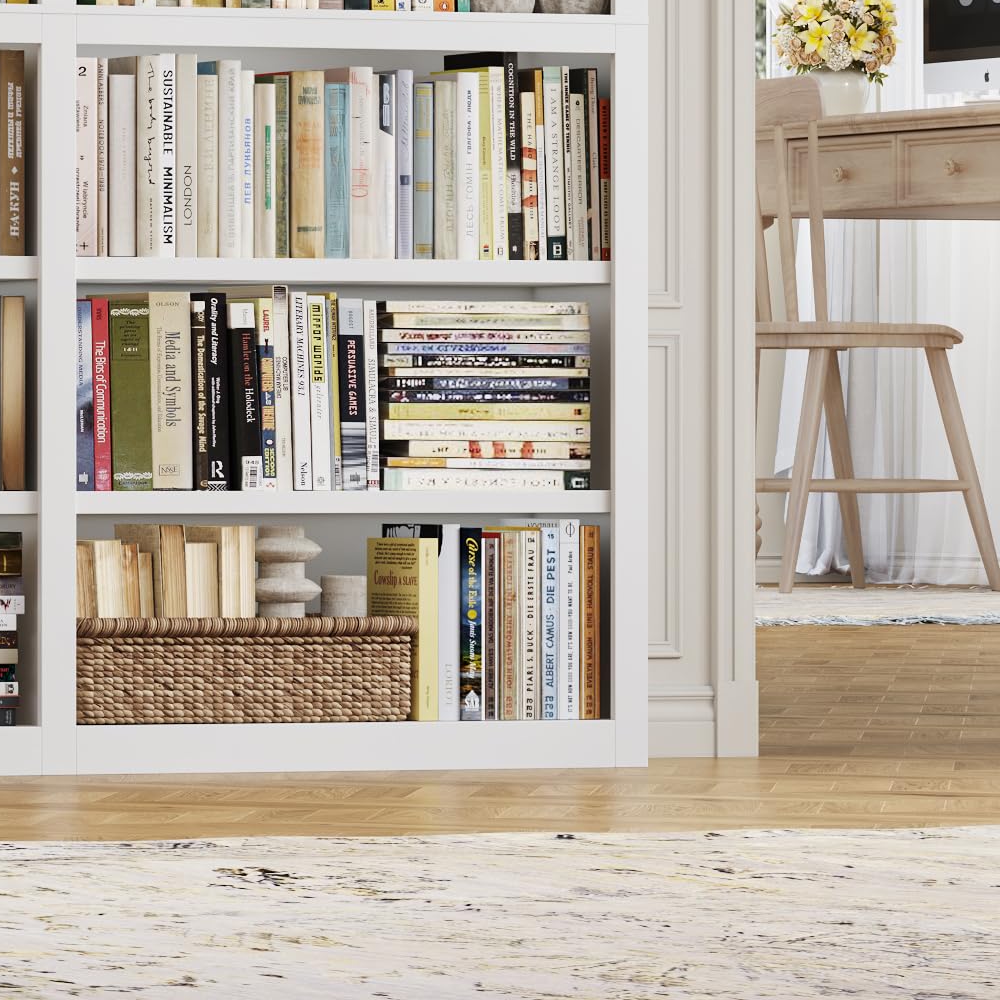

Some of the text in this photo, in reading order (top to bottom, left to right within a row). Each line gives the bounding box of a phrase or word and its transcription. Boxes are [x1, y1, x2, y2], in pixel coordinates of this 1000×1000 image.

[507, 62, 517, 107] COGNITION
[507, 109, 517, 119] IN
[507, 121, 517, 138] THE
[163, 70, 173, 244] SUSTAINABLE MINIMALISM
[507, 140, 517, 160] WILD
[183, 166, 192, 226] LONDON
[210, 298, 219, 365] Orality and Literacy
[295, 297, 304, 335] LITERARY
[312, 304, 322, 341] mirror
[95, 340, 106, 355] The
[95, 356, 106, 373] Bias
[297, 337, 305, 378] MACHINES
[313, 345, 323, 381] worlds
[95, 374, 106, 382] of
[164, 331, 181, 427] Media and Symbols
[242, 333, 254, 423] Hamlet on the Holodeck
[348, 340, 357, 416] PERSUASIVE GAMES
[95, 384, 106, 443] Communication
[300, 462, 308, 485] Nelson
[526, 550, 534, 572] FRAU
[526, 576, 534, 600] ERSTE
[466, 538, 478, 679] Curse of the Exile Janis Susan May
[526, 603, 534, 619] DIE
[546, 549, 556, 688] ALBERT CAMUS DIE PEST
[526, 630, 534, 653] BUCK
[526, 665, 534, 693] PEARL
